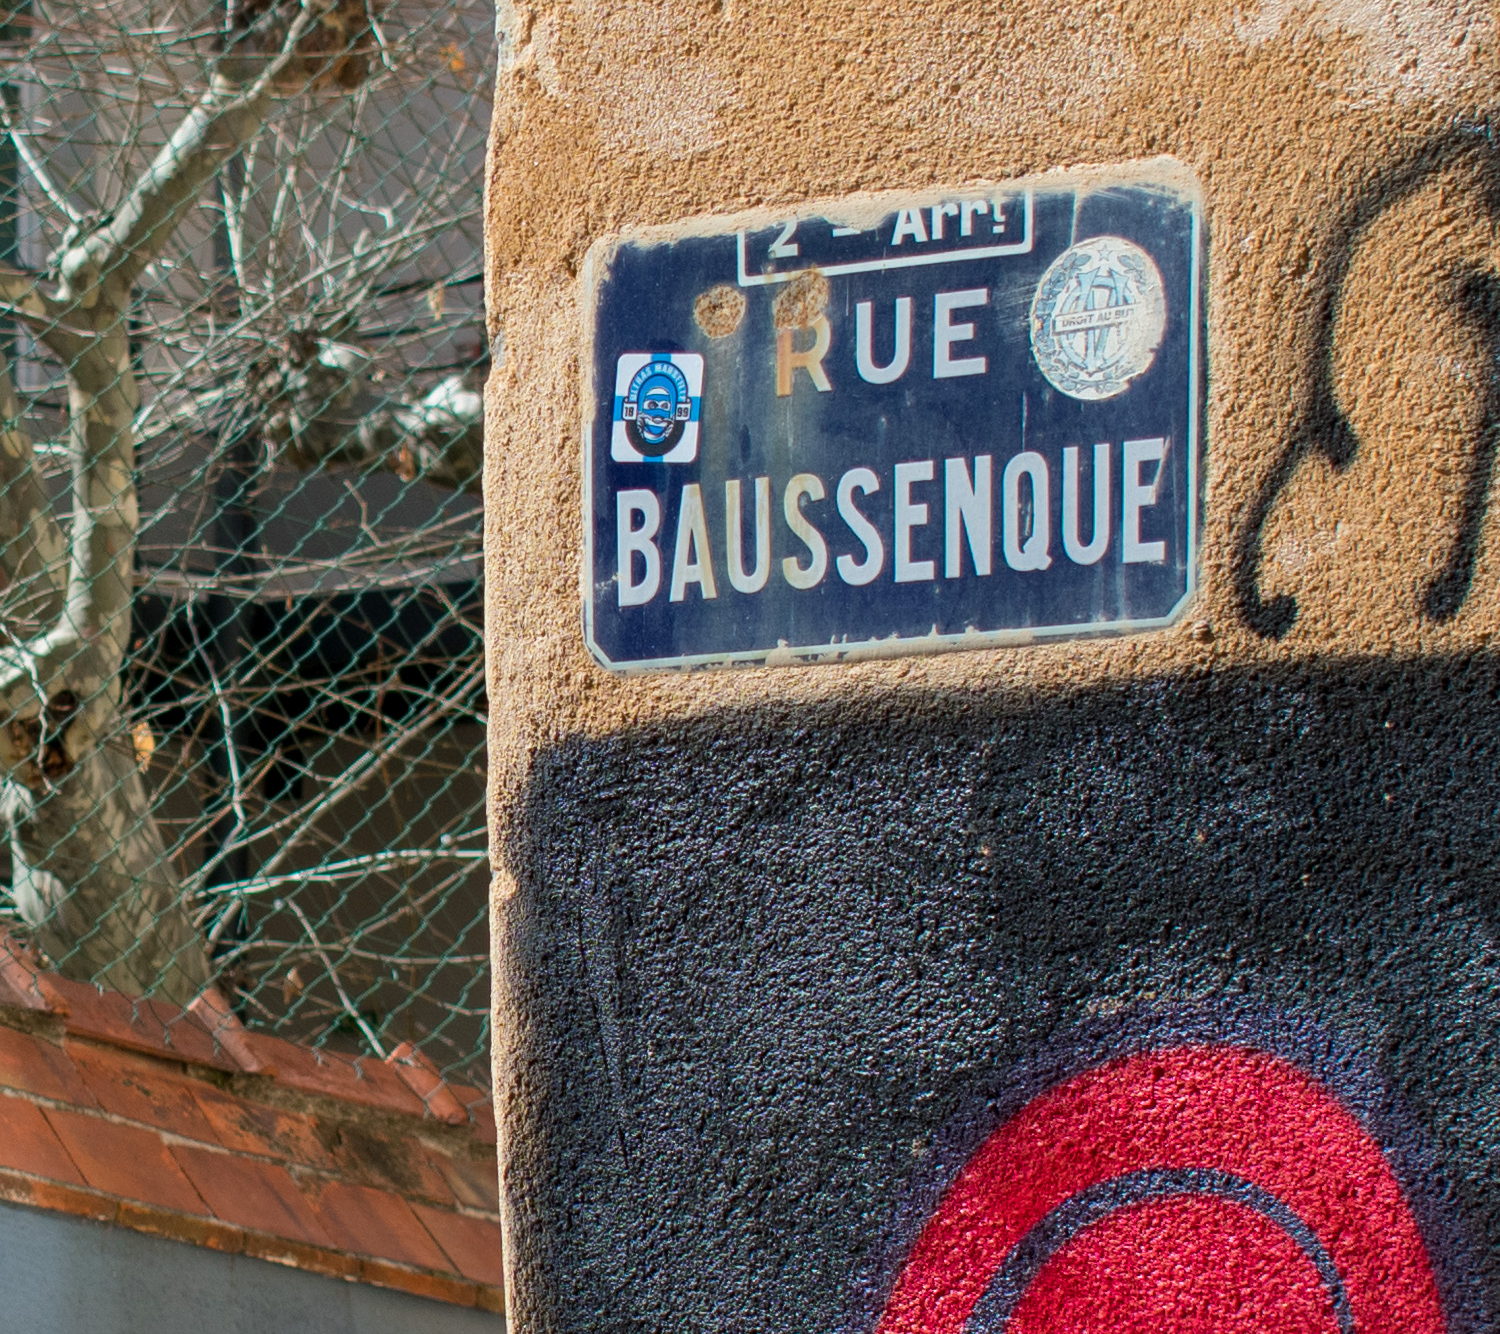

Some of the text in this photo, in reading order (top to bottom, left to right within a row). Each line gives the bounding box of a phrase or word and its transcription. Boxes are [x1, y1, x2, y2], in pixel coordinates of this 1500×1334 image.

[775, 288, 988, 398] RUE
[677, 407, 689, 418] 99
[616, 437, 1166, 608] BAUSSENQUE
